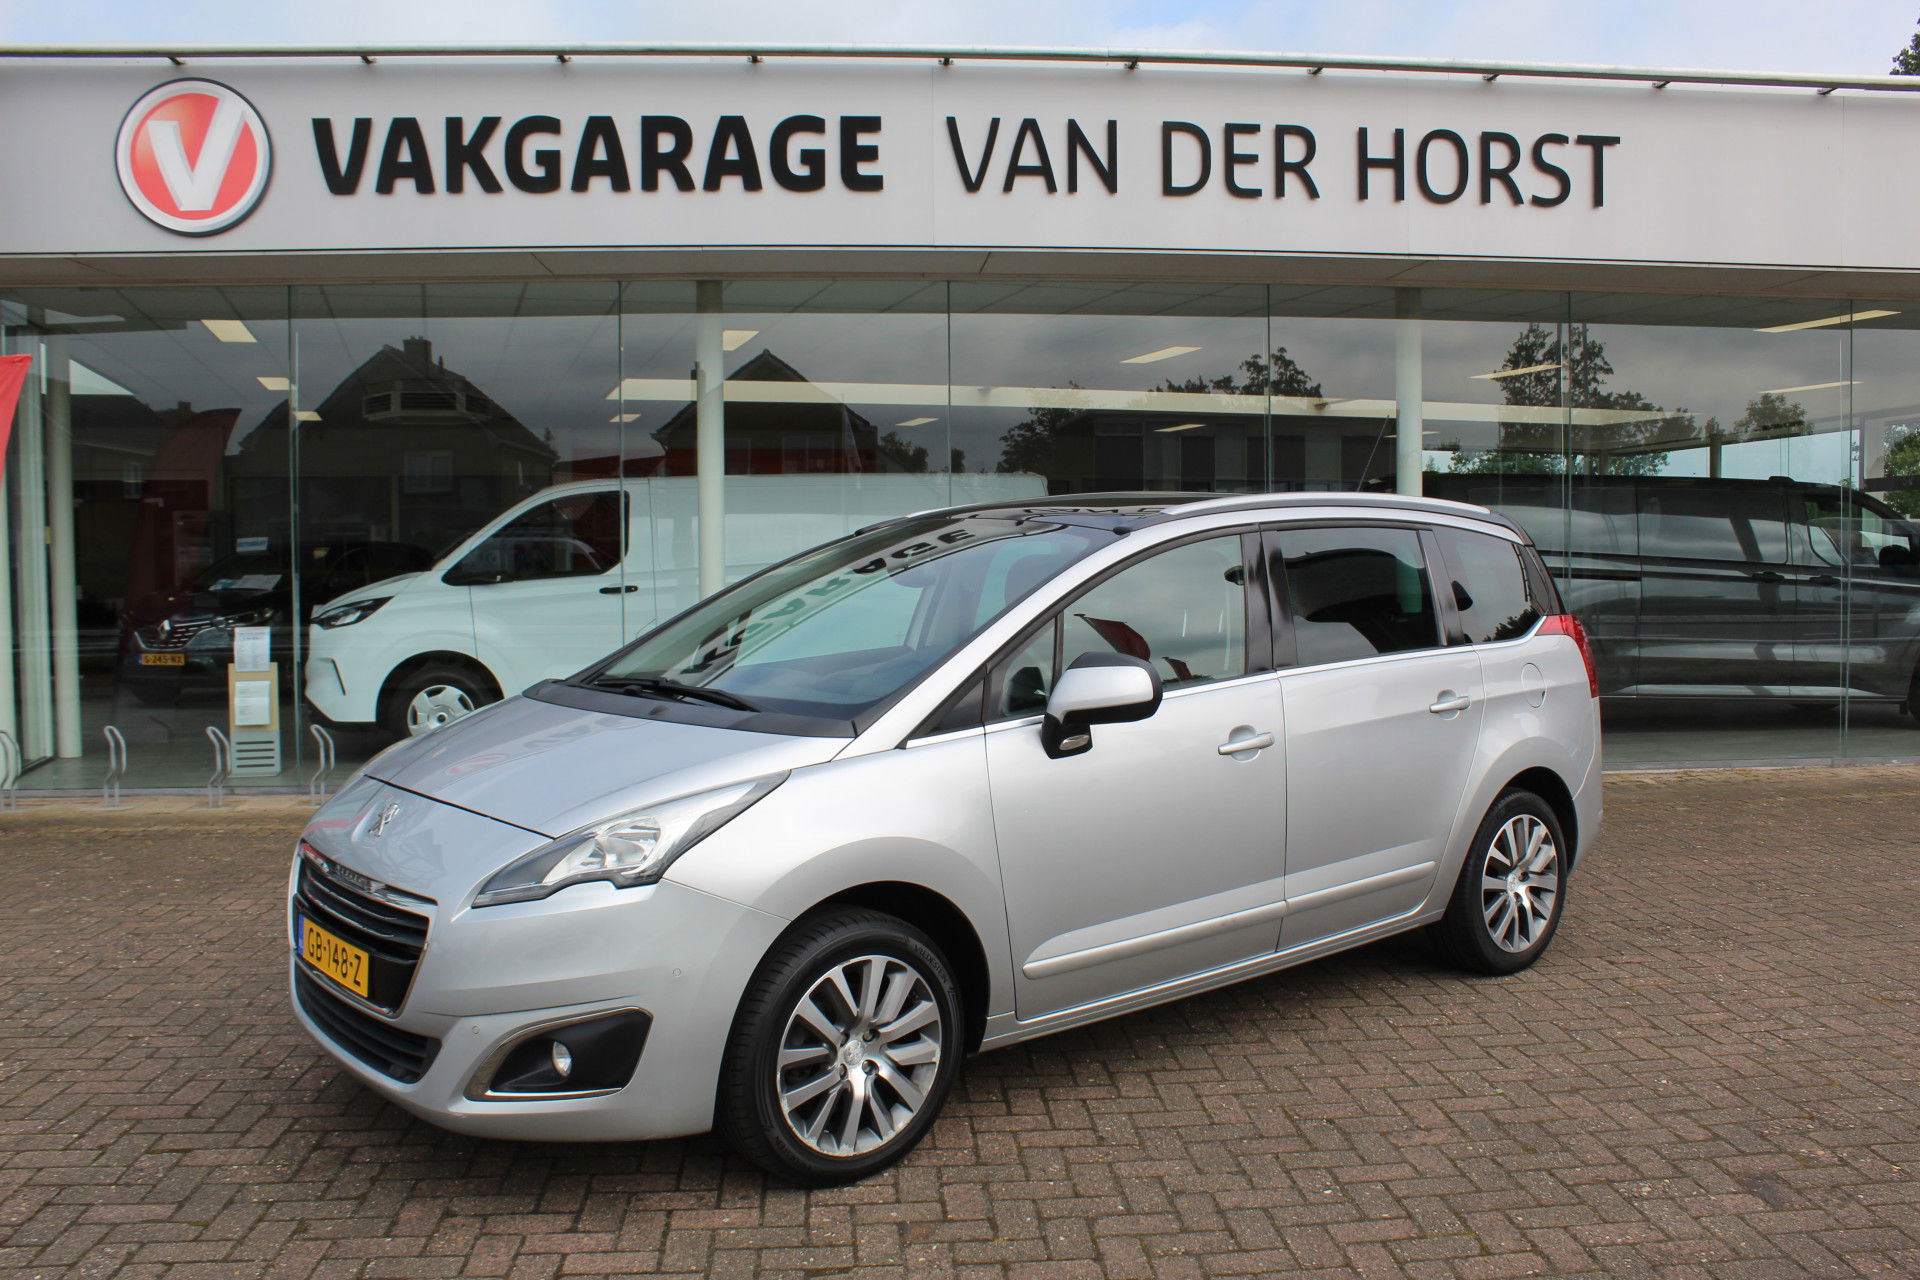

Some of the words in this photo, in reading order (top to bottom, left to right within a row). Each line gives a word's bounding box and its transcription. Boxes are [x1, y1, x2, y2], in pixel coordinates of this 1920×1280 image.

[147, 92, 246, 212] V
[311, 115, 884, 197] VAKGARAGE
[946, 116, 1118, 195] VAN
[1161, 120, 1321, 200] DER
[1357, 126, 1621, 209] HORST
[308, 926, 362, 987] GB-148-Z
